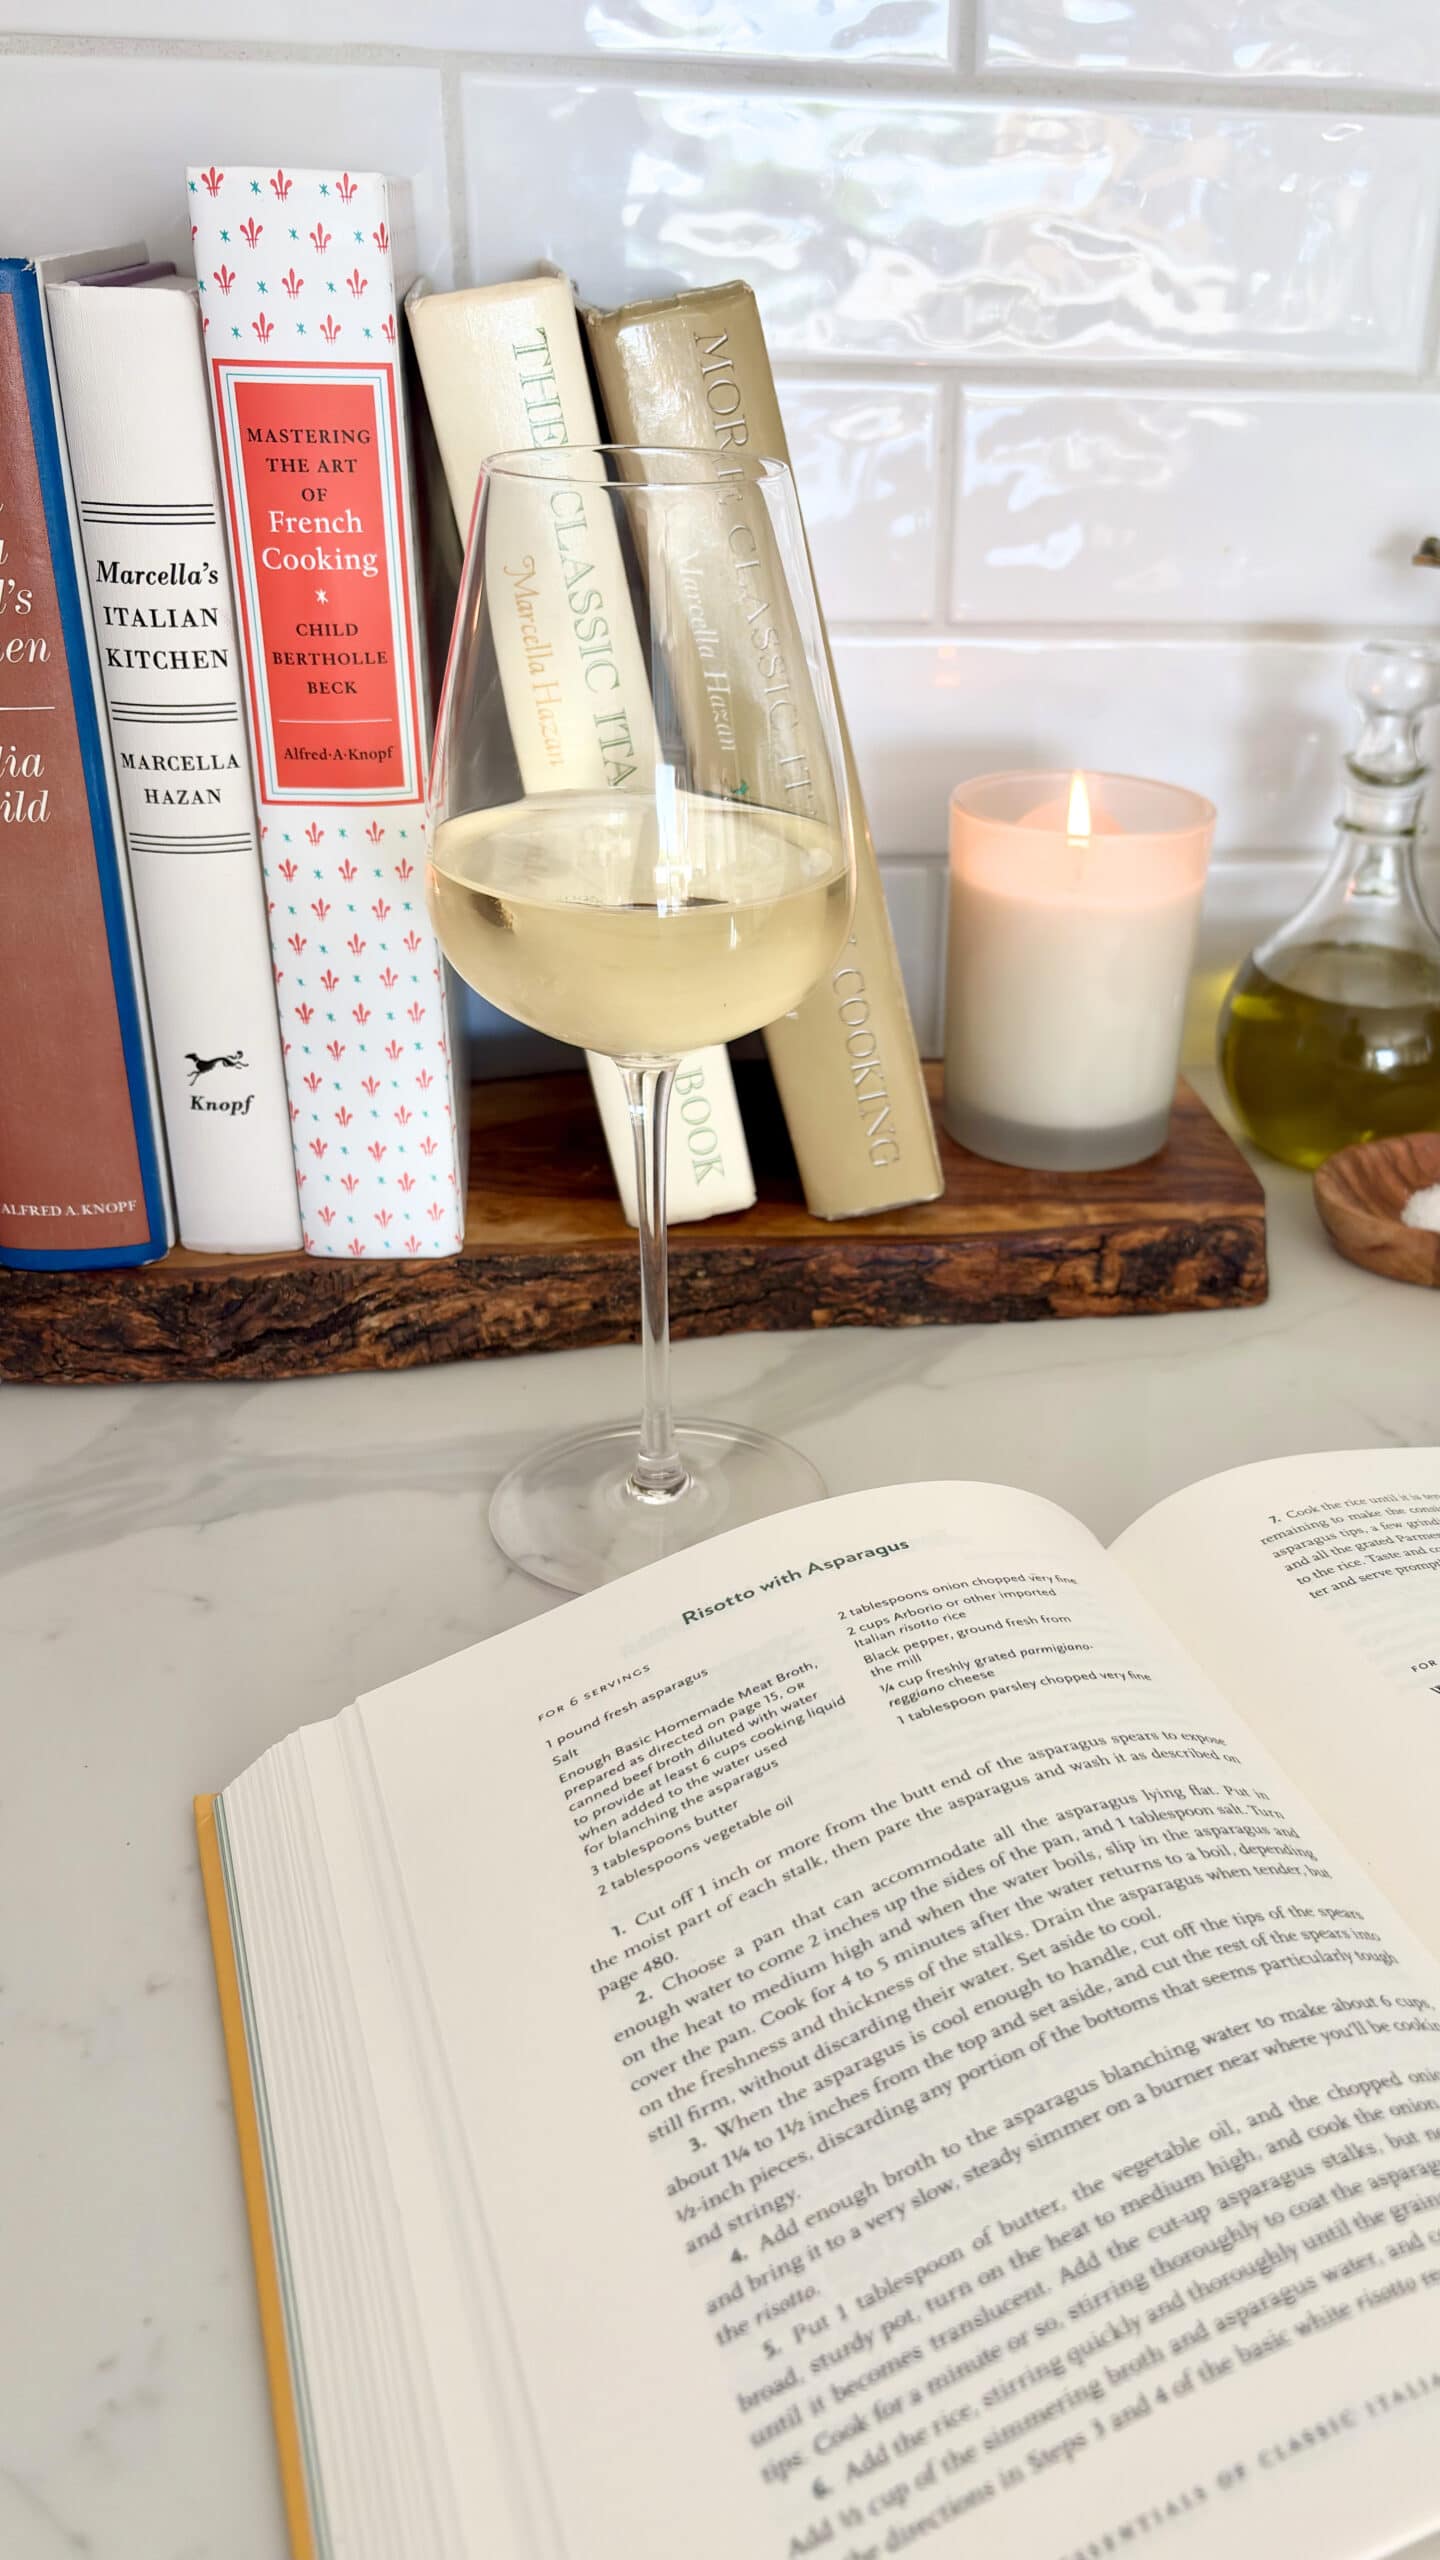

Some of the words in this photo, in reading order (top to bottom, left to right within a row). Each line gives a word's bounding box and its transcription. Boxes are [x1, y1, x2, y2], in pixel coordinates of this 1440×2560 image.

[247, 427, 371, 444] MASTERING
[266, 458, 309, 473] THE
[317, 458, 358, 473] ART
[301, 488, 328, 502] OF
[269, 509, 364, 534] French
[95, 559, 219, 586] Marcella's
[262, 546, 379, 578] Cooking
[512, 327, 569, 449] THE
[550, 490, 620, 695] CLASSIC
[593, 708, 639, 790] ITA
[103, 606, 219, 628] ITALIAN
[296, 623, 359, 638] CHILD
[105, 648, 229, 670] KITCHEN
[272, 650, 388, 666] BERTHOLLE
[504, 555, 554, 676] Marcella
[532, 680, 566, 768] Hazan
[307, 681, 358, 695] BECK
[703, 671, 736, 752] Hazan
[120, 752, 241, 771] MARCELLA
[144, 788, 222, 805] HAZAN
[832, 968, 901, 1169] COOKING
[190, 1094, 255, 1116] Knopf
[674, 1065, 726, 1186] BOOK
[1, 1202, 62, 1217] ALFRED
[65, 1202, 79, 1217] A.
[81, 1200, 138, 1216] KNOPF
[1311, 1567, 1336, 1579] the
[1366, 1551, 1402, 1563] Taste
[1402, 1545, 1427, 1557] and
[681, 1589, 755, 1625] Risotto
[758, 1569, 802, 1592] with
[807, 1541, 910, 1576] Asparagus
[837, 1611, 847, 1621] 2
[848, 1589, 929, 1616] tablespoons
[931, 1581, 969, 1594] onion
[971, 1573, 1026, 1586] chopped
[1028, 1573, 1053, 1584] very
[1054, 1574, 1077, 1584] fine
[1308, 1586, 1329, 1599] ter
[1330, 1575, 1358, 1591] and
[1357, 1568, 1393, 1582] serve
[846, 1626, 857, 1636] 2
[858, 1617, 891, 1632] cups
[894, 1603, 943, 1622] Arborio
[945, 1599, 959, 1608] or
[962, 1593, 996, 1604] other
[998, 1588, 1056, 1599] imported
[853, 1629, 896, 1648] Italian
[898, 1617, 939, 1634] risotto
[942, 1611, 967, 1622] rice
[863, 1645, 900, 1664] Black
[902, 1633, 954, 1654] pepper,
[956, 1619, 1004, 1639] ground
[1005, 1615, 1039, 1627] fresh
[1039, 1614, 1071, 1623] from
[869, 1664, 893, 1677] the
[896, 1652, 922, 1669] mill
[897, 1674, 923, 1688] cup
[925, 1660, 970, 1679] freshly
[973, 1648, 1017, 1668] grated
[1410, 1659, 1438, 1673] FOR
[537, 1704, 565, 1722] FOR
[569, 1696, 578, 1707] 6
[583, 1664, 650, 1700] SERVINGS
[545, 1739, 552, 1749] 1
[556, 1715, 601, 1747] pound
[603, 1700, 638, 1722] fresh
[641, 1668, 708, 1705] asparagus
[888, 1683, 945, 1708] reggiano
[947, 1670, 995, 1688] cheese
[896, 1715, 905, 1725] 1
[907, 1691, 986, 1721] tablespoon
[988, 1680, 1036, 1699] parsley
[1039, 1670, 1097, 1686] chopped
[1099, 1672, 1126, 1681] very
[1127, 1670, 1152, 1681] fine
[558, 1753, 612, 1784] Enough
[614, 1734, 652, 1757] Basic
[653, 1696, 735, 1739] Homemade
[737, 1679, 774, 1700] Meat
[775, 1662, 818, 1683] Broth,
[563, 1761, 626, 1800] prepared
[629, 1754, 645, 1767] as
[648, 1723, 704, 1758] directed
[707, 1716, 725, 1730] on
[728, 1700, 762, 1723] page
[762, 1691, 783, 1704] 15,
[786, 1681, 805, 1694] OR
[551, 1748, 579, 1767] Salt
[568, 1780, 620, 1812] canned
[621, 1763, 653, 1787] beef
[655, 1747, 694, 1771] broth
[697, 1722, 745, 1751] diluted
[747, 1709, 778, 1727] with
[779, 1692, 817, 1713] water
[572, 1815, 589, 1827] to
[592, 1787, 645, 1821] provide
[648, 1778, 662, 1792] at
[663, 1761, 699, 1783] least
[700, 1754, 711, 1766] 6
[713, 1740, 747, 1760] cups
[749, 1714, 806, 1743] cooking
[805, 1694, 846, 1719] liquid
[578, 1818, 617, 1841] when
[621, 1792, 665, 1822] added
[667, 1787, 683, 1799] to
[685, 1774, 709, 1790] the
[711, 1754, 750, 1777] water
[753, 1735, 788, 1758] used
[583, 1840, 604, 1856] for
[607, 1806, 679, 1845] blanching
[680, 1794, 704, 1810] the
[707, 1759, 779, 1798] asparagus
[590, 1864, 600, 1876] 3
[602, 1823, 692, 1870] tablespoons
[693, 1799, 737, 1827] butter
[597, 1884, 608, 1897] 2
[610, 1842, 700, 1890] tablespoons
[702, 1808, 772, 1845] vegetable
[775, 1794, 794, 1811] oil
[610, 1925, 627, 1937] 1.
[634, 1905, 666, 1926] Cut
[670, 1887, 693, 1910] off
[697, 1884, 707, 1896] 1
[711, 1864, 751, 1890] inch
[754, 1854, 771, 1869] or
[777, 1833, 821, 1859] more
[824, 1813, 867, 1837] from
[869, 1799, 897, 1816] the
[900, 1783, 937, 1804] butt
[940, 1768, 972, 1789] end
[975, 1760, 992, 1776] of
[995, 1755, 1023, 1770] the
[1027, 1737, 1107, 1761] asparagus
[1110, 1732, 1159, 1746] spears
[1161, 1731, 1178, 1741] to
[1180, 1732, 1226, 1746] expose
[597, 1970, 639, 2001] page
[642, 1951, 679, 1973] 480.
[685, 2221, 724, 2255] and
[725, 2188, 801, 2233] stringy.
[714, 2319, 750, 2347] the
